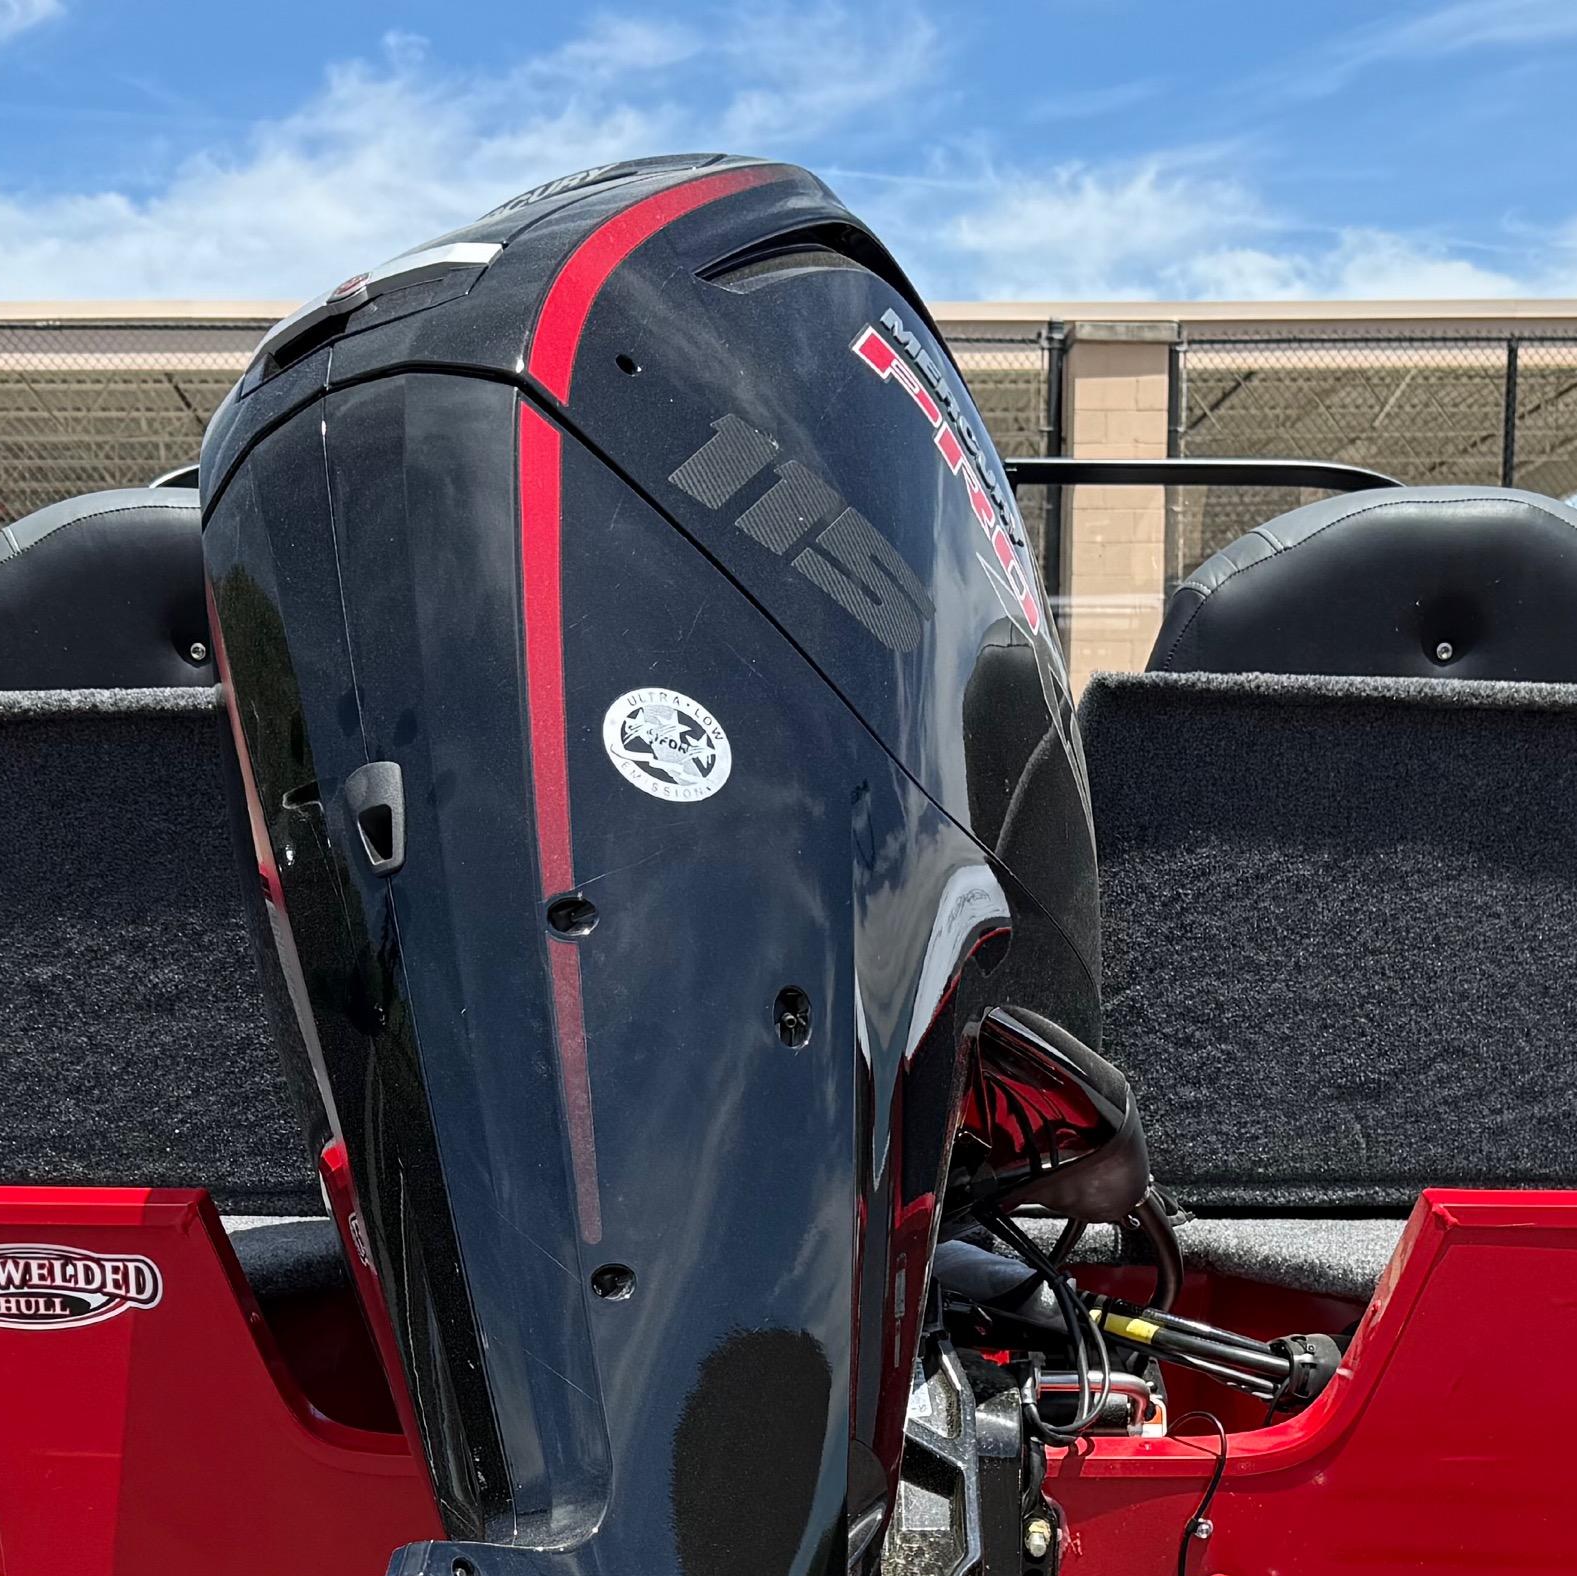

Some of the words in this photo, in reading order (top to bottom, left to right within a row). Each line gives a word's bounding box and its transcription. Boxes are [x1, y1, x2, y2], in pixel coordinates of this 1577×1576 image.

[667, 413, 936, 652] 115
[627, 691, 681, 707] ULTRA
[695, 708, 724, 740] LOW
[620, 760, 704, 799] EMSSION
